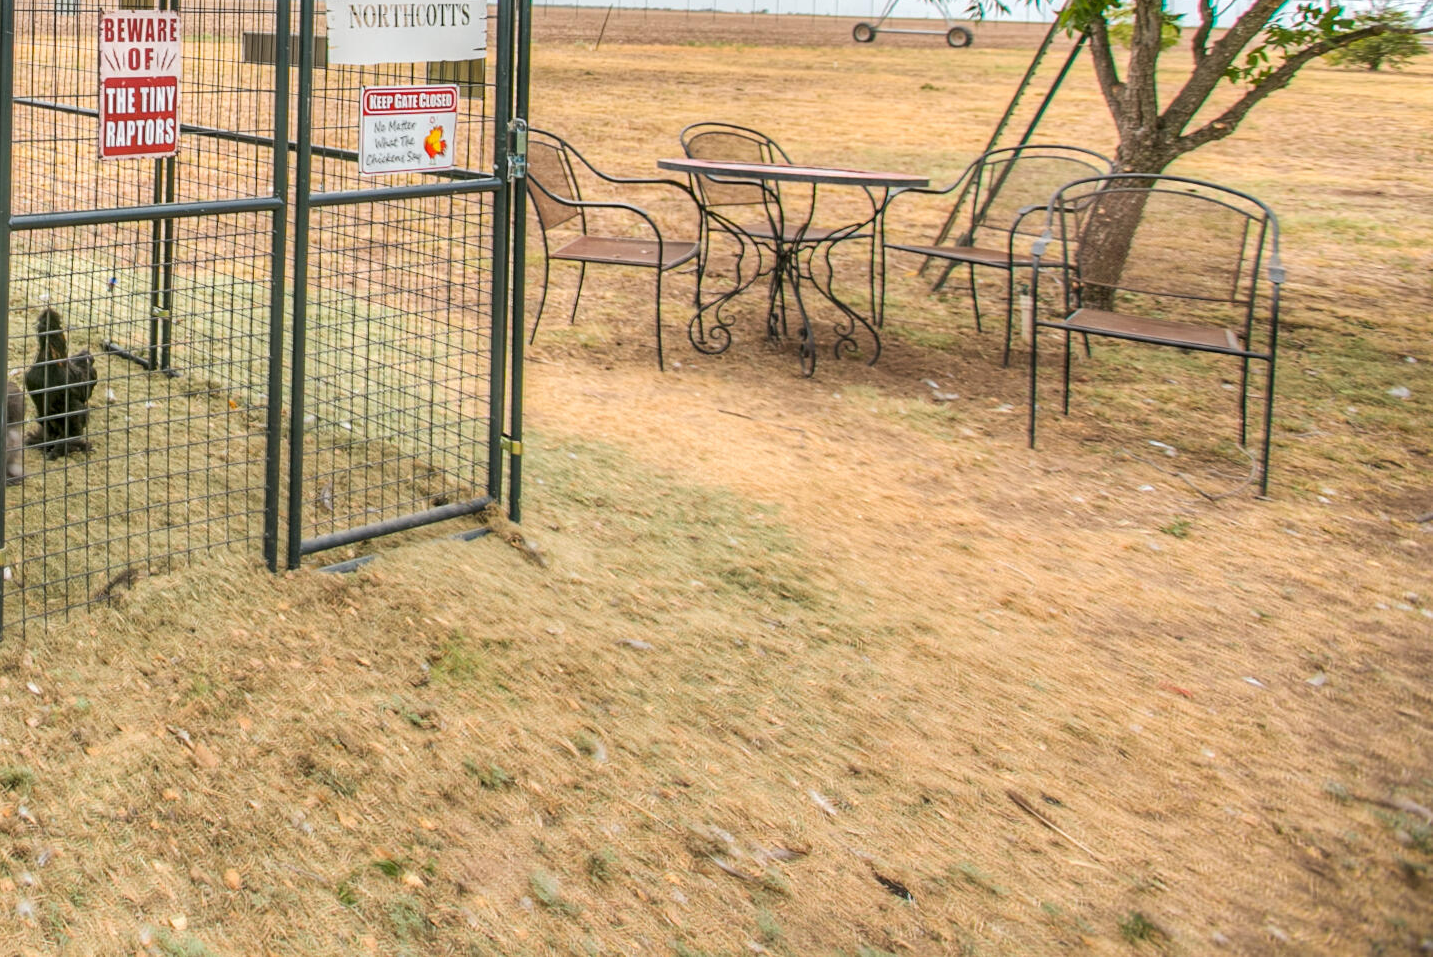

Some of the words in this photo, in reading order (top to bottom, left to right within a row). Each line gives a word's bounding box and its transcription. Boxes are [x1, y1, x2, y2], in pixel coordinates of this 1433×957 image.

[104, 18, 177, 43] BEWARE
[128, 47, 154, 71] OF
[105, 87, 136, 115] THE
[139, 85, 175, 114] TINY
[105, 118, 175, 147] RAPTORS
[374, 120, 386, 133] No
[374, 137, 398, 149] What
[400, 135, 415, 147] The
